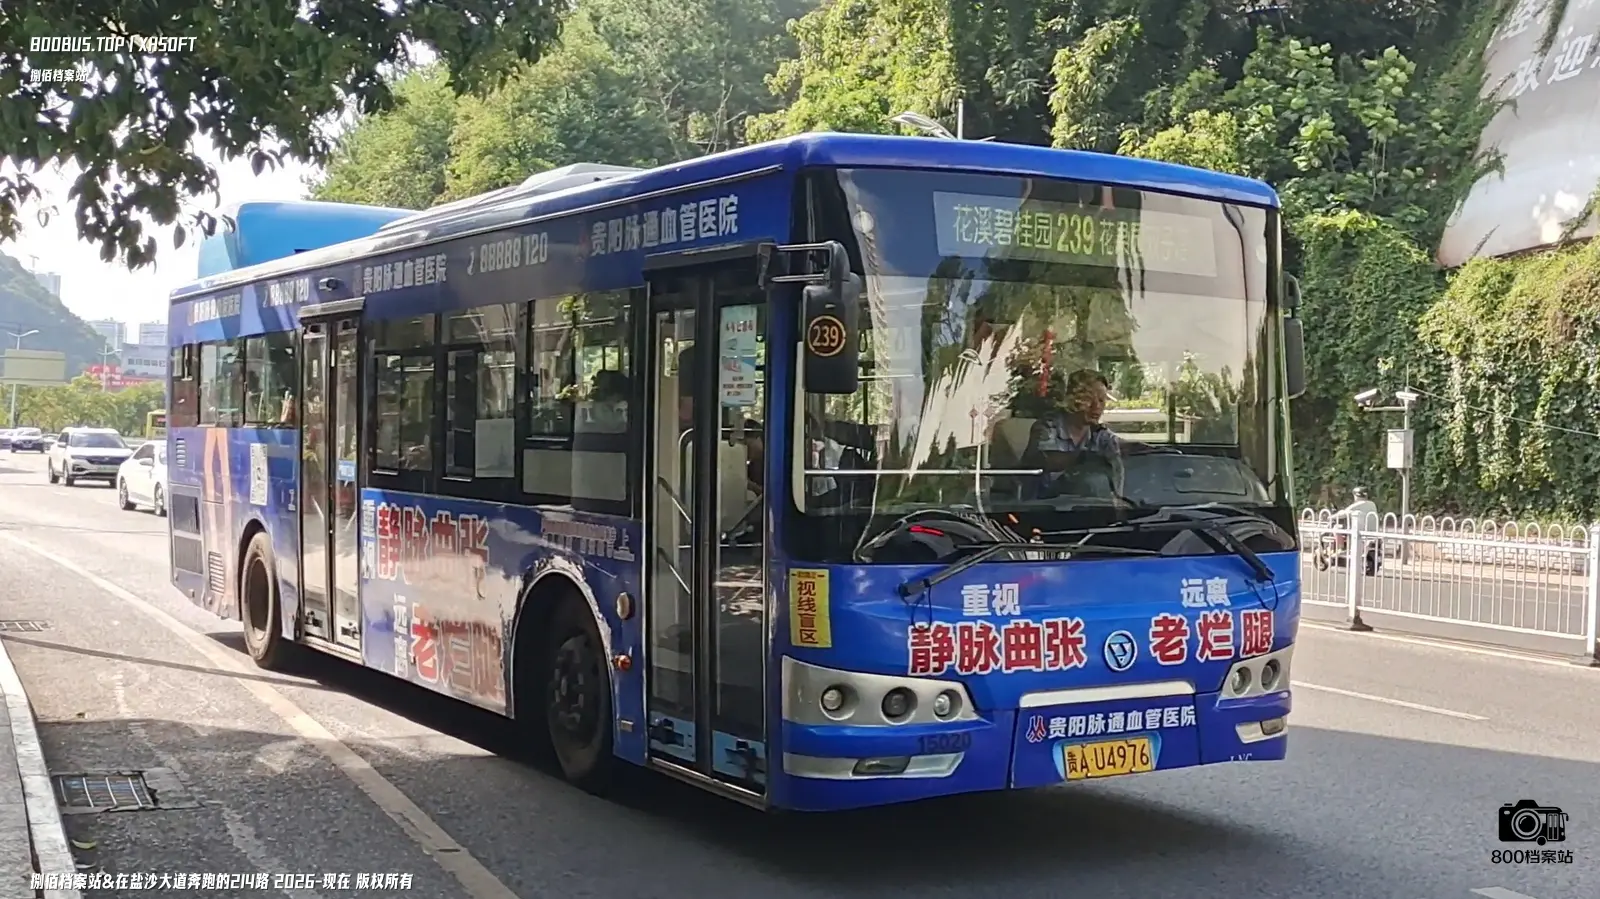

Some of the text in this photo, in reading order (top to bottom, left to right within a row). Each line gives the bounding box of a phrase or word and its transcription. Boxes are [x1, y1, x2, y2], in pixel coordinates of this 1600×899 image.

[590, 194, 739, 257] 贵阳脉通血管医院
[952, 203, 1053, 250] 花溪碧桂园
[1056, 213, 1095, 256] 239
[812, 325, 840, 347] 239
[961, 583, 1021, 616] 重视
[1181, 577, 1231, 608] 远离
[907, 617, 1087, 676] 静脉曲张
[1149, 608, 1275, 665] 老烂腿
[1048, 705, 1197, 739] 贵阳脉通血管医院
